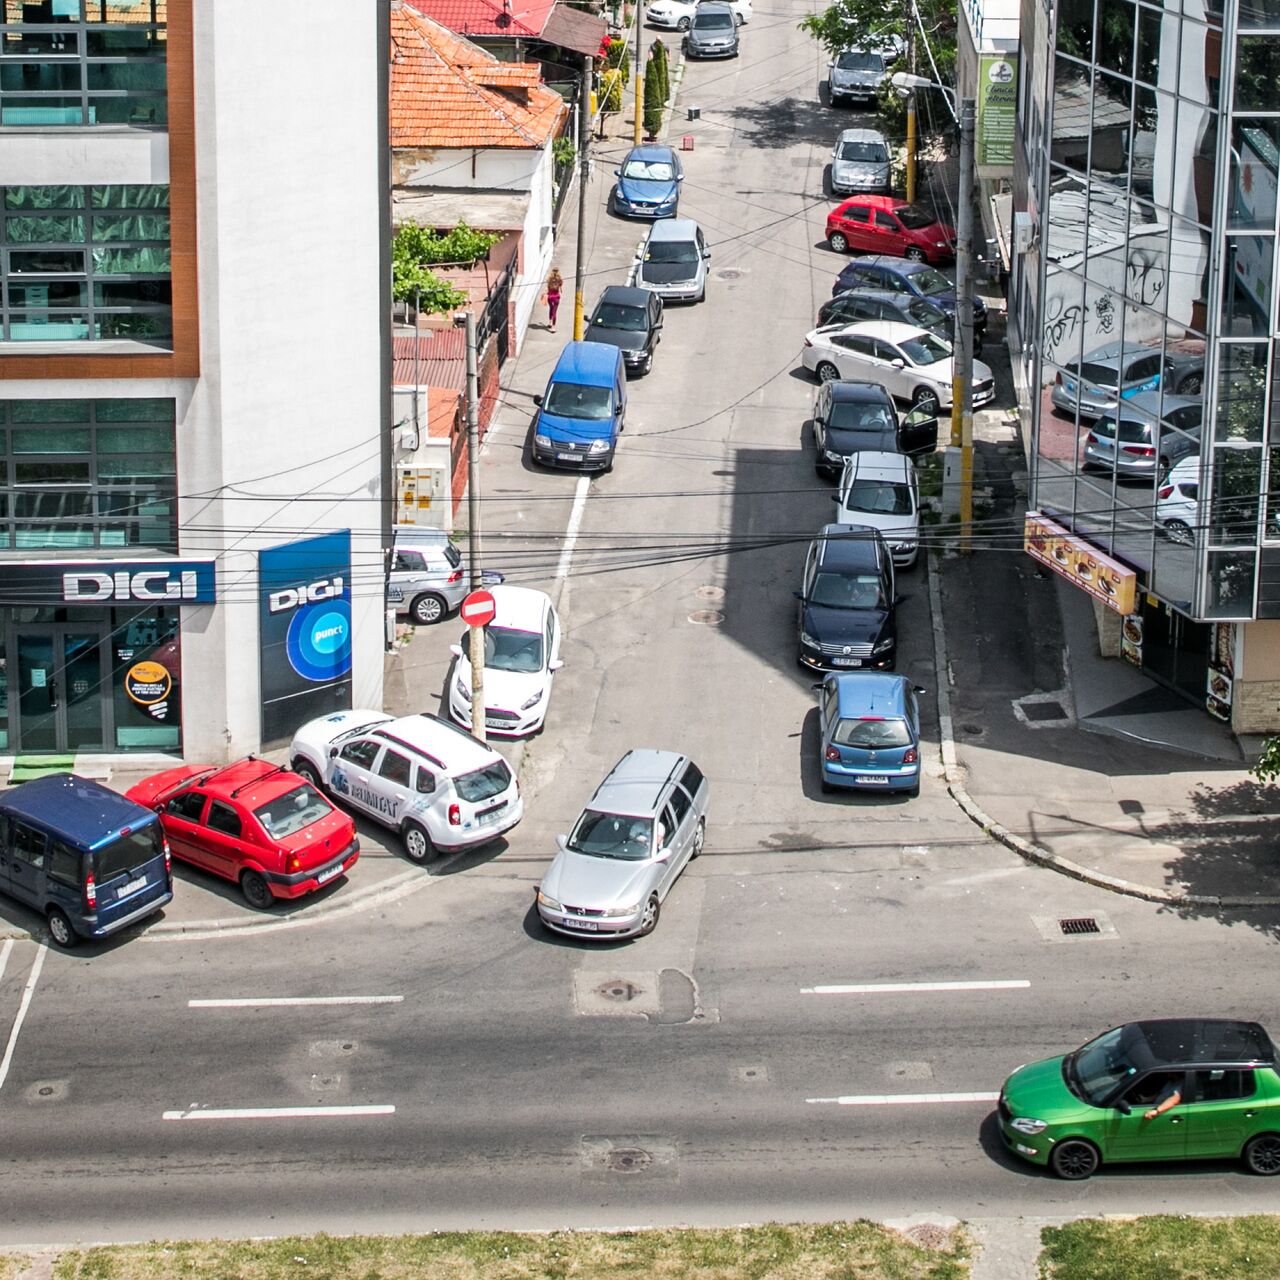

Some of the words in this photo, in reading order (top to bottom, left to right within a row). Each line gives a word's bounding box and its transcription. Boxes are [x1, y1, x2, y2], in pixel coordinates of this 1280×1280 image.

[63, 570, 197, 601] DIGI
[269, 577, 344, 613] DIGI
[314, 624, 344, 643] punct
